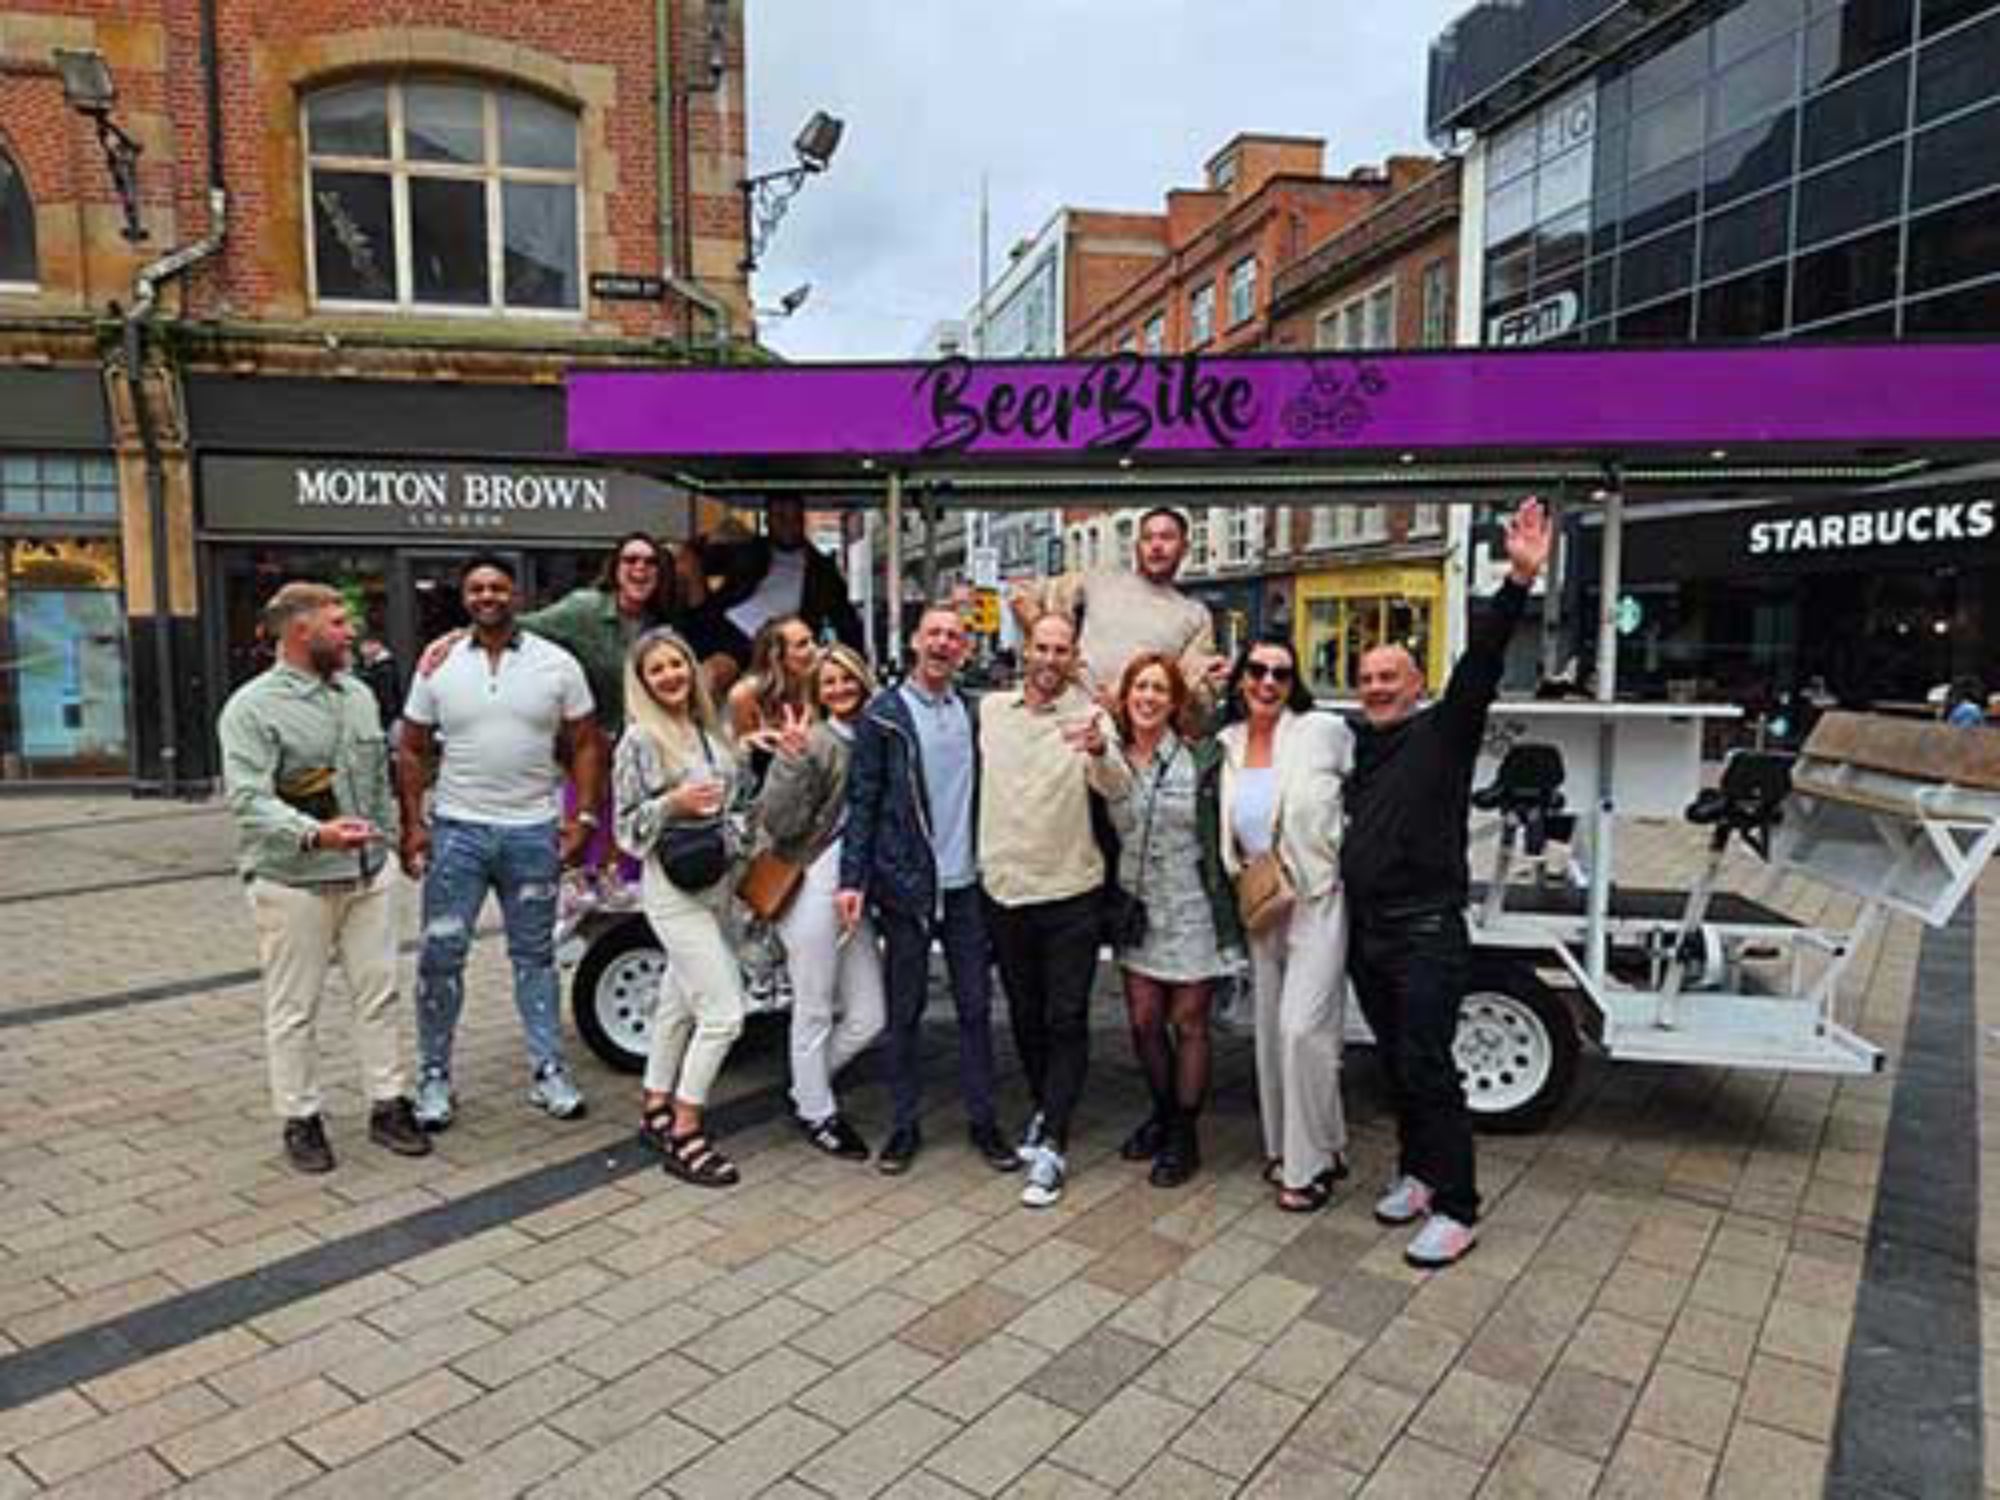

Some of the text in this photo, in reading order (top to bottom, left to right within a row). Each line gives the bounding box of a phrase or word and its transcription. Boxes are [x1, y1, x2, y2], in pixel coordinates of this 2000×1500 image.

[296, 469, 608, 511] MOLTON BROWN
[1748, 500, 1995, 554] STARBUCKS
